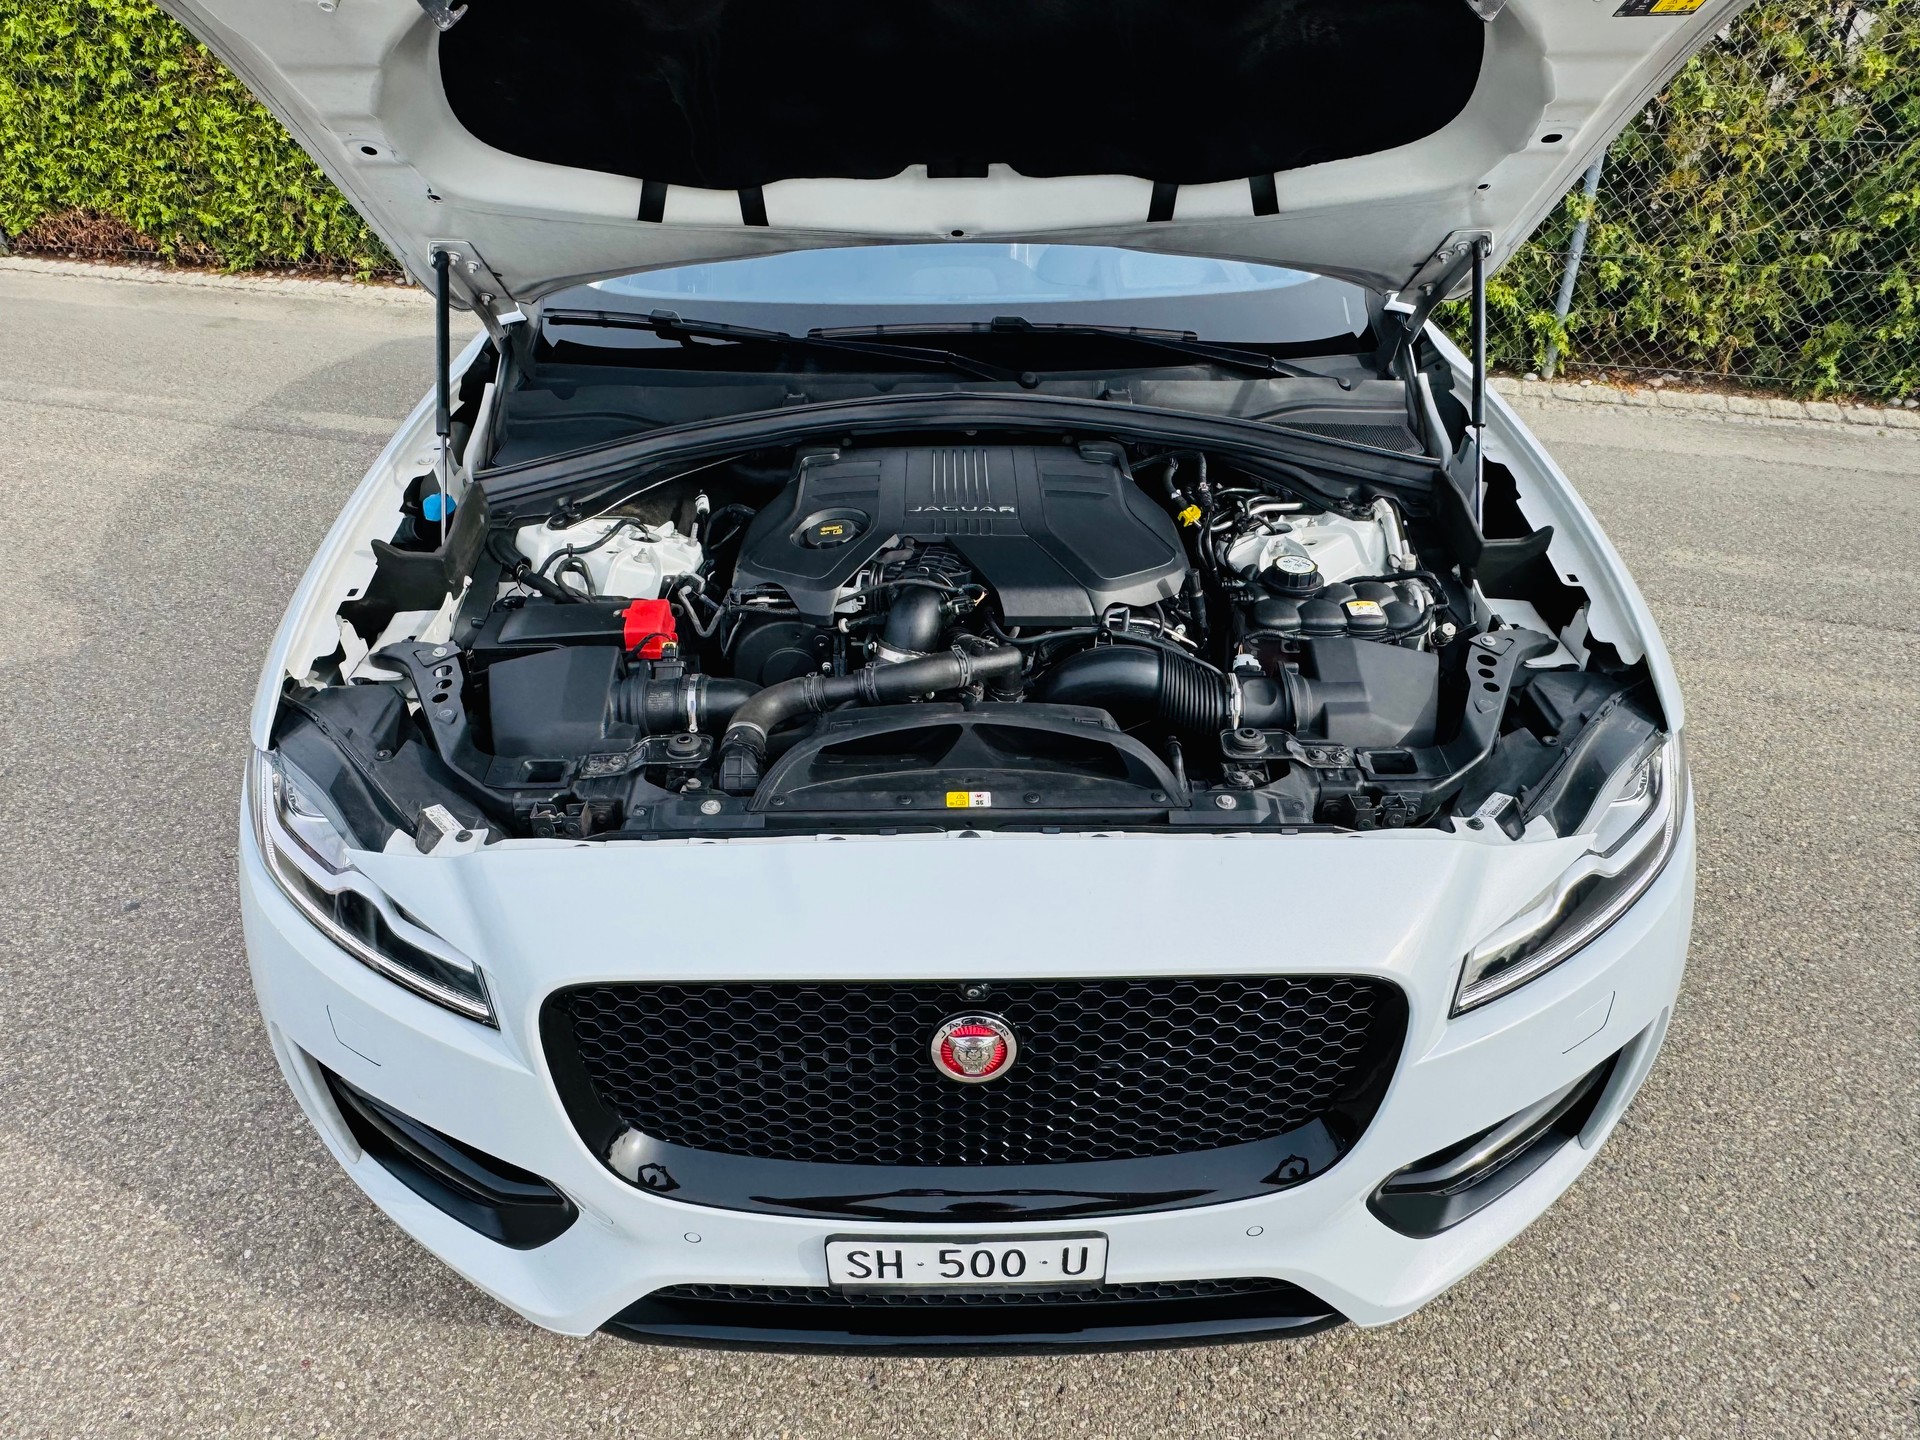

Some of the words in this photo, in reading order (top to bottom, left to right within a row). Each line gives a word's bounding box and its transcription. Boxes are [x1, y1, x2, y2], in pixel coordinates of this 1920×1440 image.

[846, 1249, 904, 1279] SH
[938, 1248, 1027, 1278] 500
[1061, 1245, 1089, 1276] U
